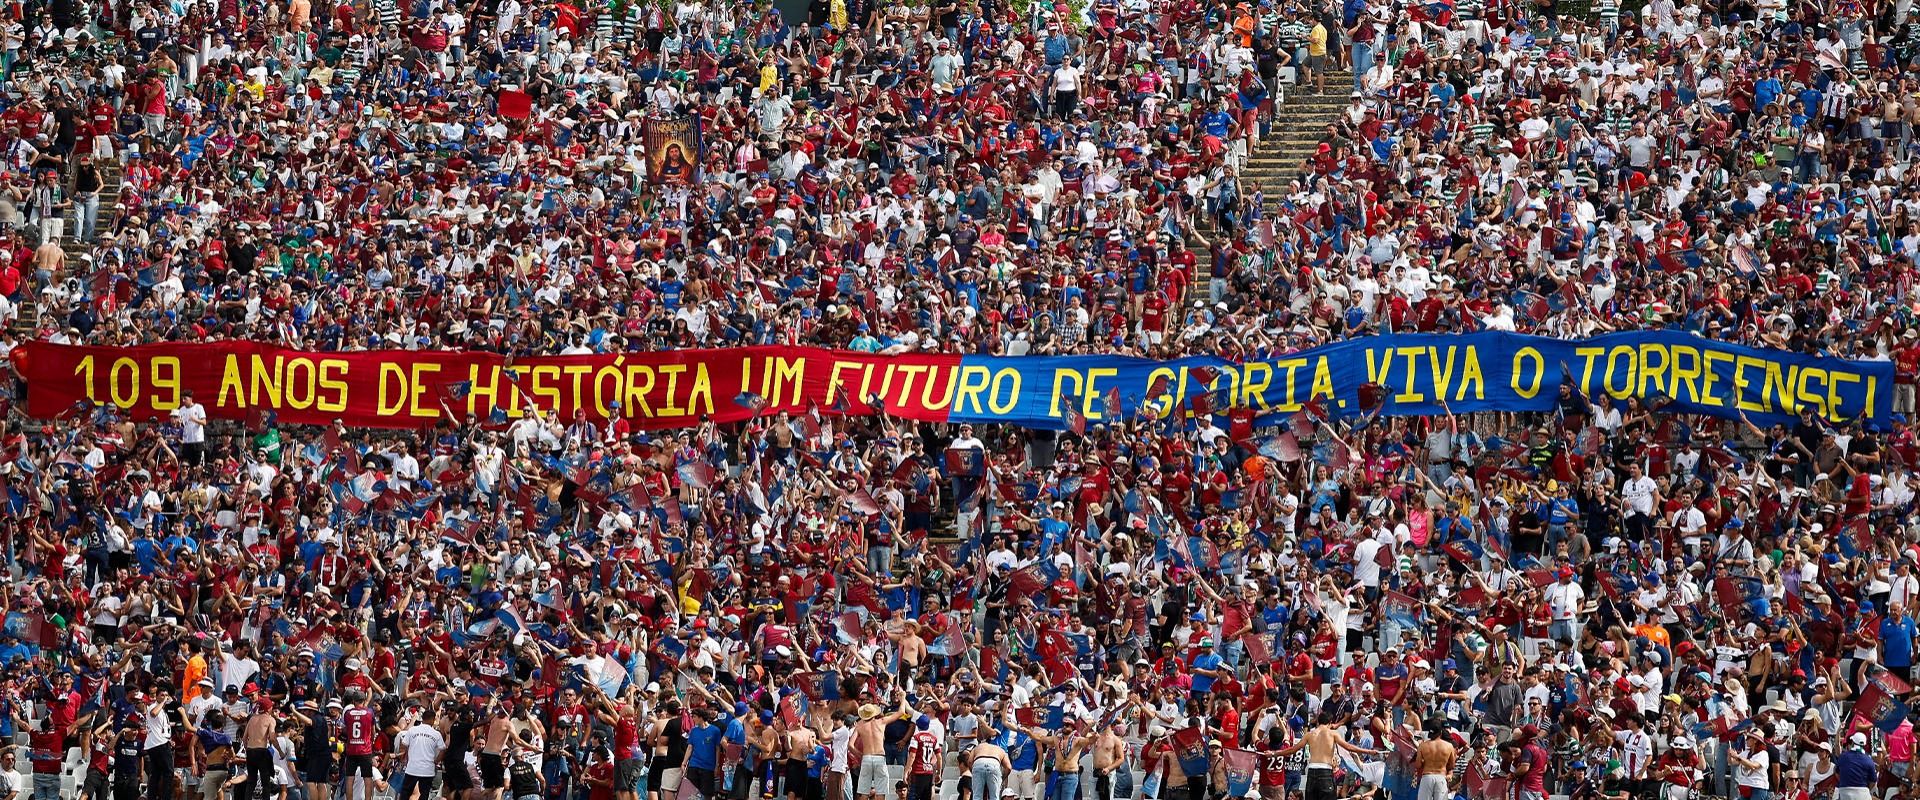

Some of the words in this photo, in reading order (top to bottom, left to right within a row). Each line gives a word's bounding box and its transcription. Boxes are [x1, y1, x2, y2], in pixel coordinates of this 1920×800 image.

[75, 355, 181, 411] 109
[217, 353, 349, 412] ANOS
[377, 362, 442, 417] DE
[467, 354, 715, 419] HISTÓRIA
[740, 356, 806, 408] UM
[825, 361, 1021, 414] FUTURO
[1049, 368, 1118, 419] DE
[1365, 345, 1485, 402] VIVA
[1511, 346, 1545, 399] O
[352, 721, 362, 739] 6
[1266, 755, 1284, 771] 23
